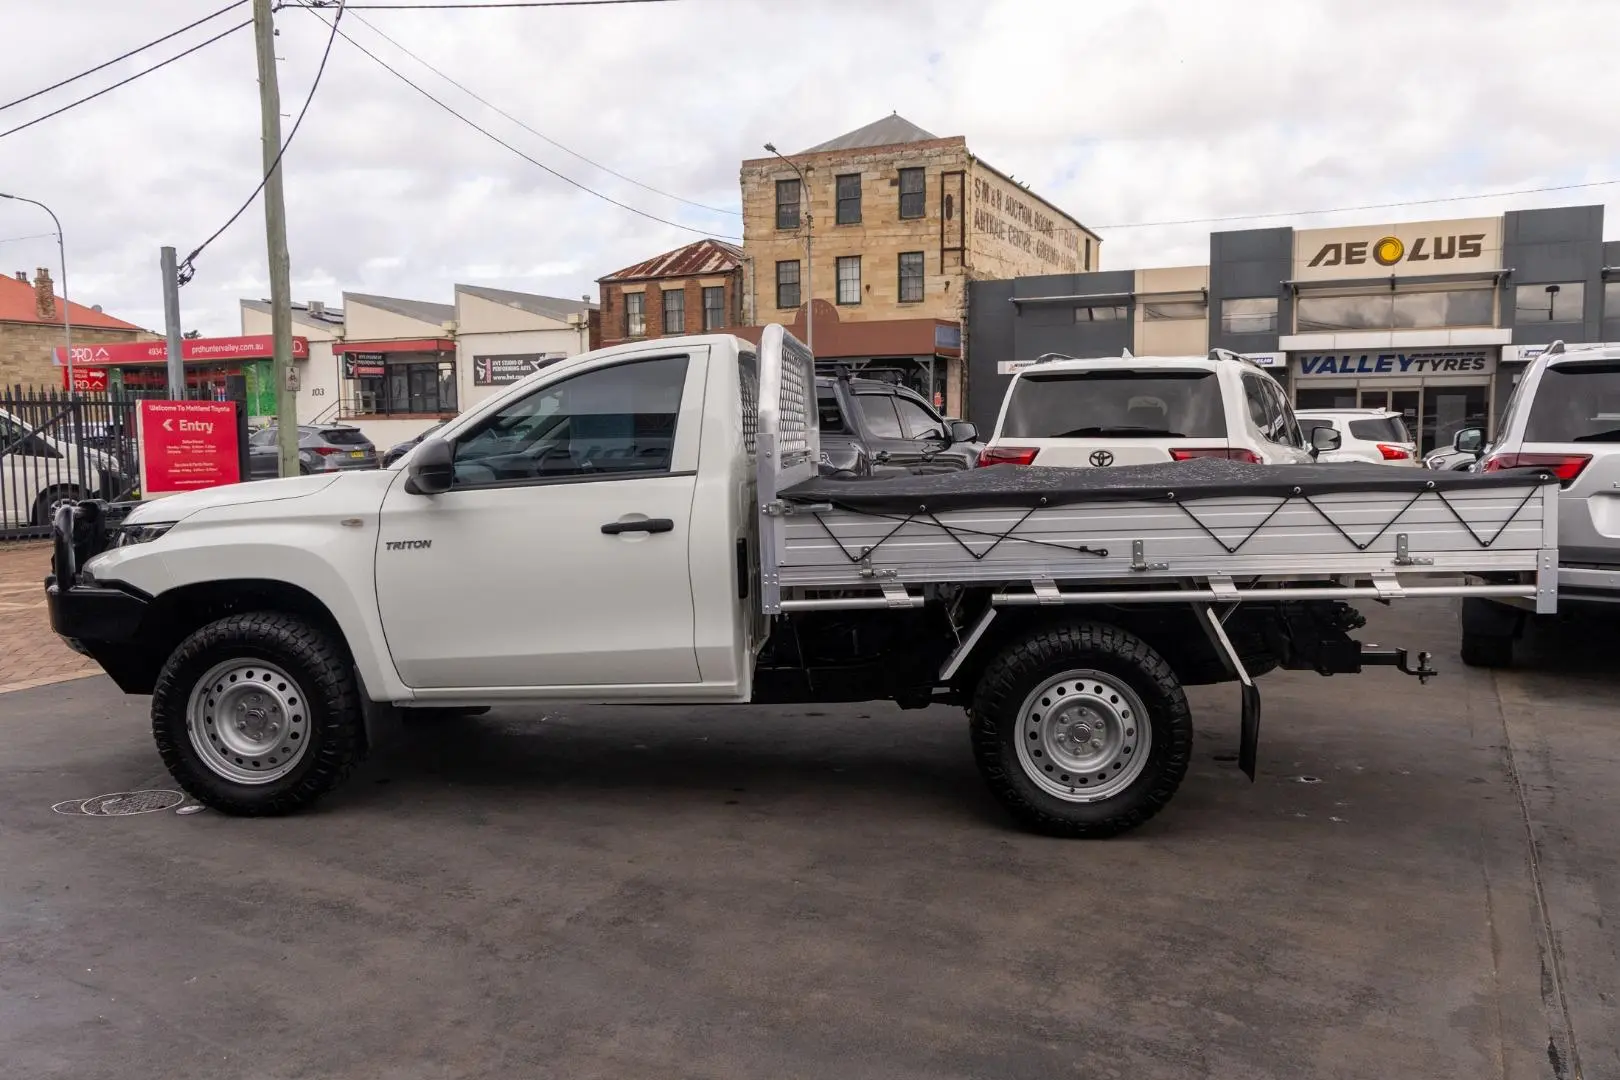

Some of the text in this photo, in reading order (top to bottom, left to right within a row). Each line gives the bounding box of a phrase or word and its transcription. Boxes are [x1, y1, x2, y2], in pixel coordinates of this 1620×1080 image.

[1005, 194, 1033, 228] AUCTION
[1034, 210, 1054, 239] ROOMS
[974, 207, 1005, 240] ANTIQUE
[1008, 225, 1031, 253] CENTRE
[1307, 234, 1486, 267] AEOLUS
[191, 343, 264, 355] prdhuntervalley.com.au
[1300, 354, 1486, 375] VALLEY TYRES
[311, 387, 325, 396] 103
[148, 404, 177, 412] Welcome
[179, 420, 213, 434] Entry
[386, 540, 432, 550] TRITON
